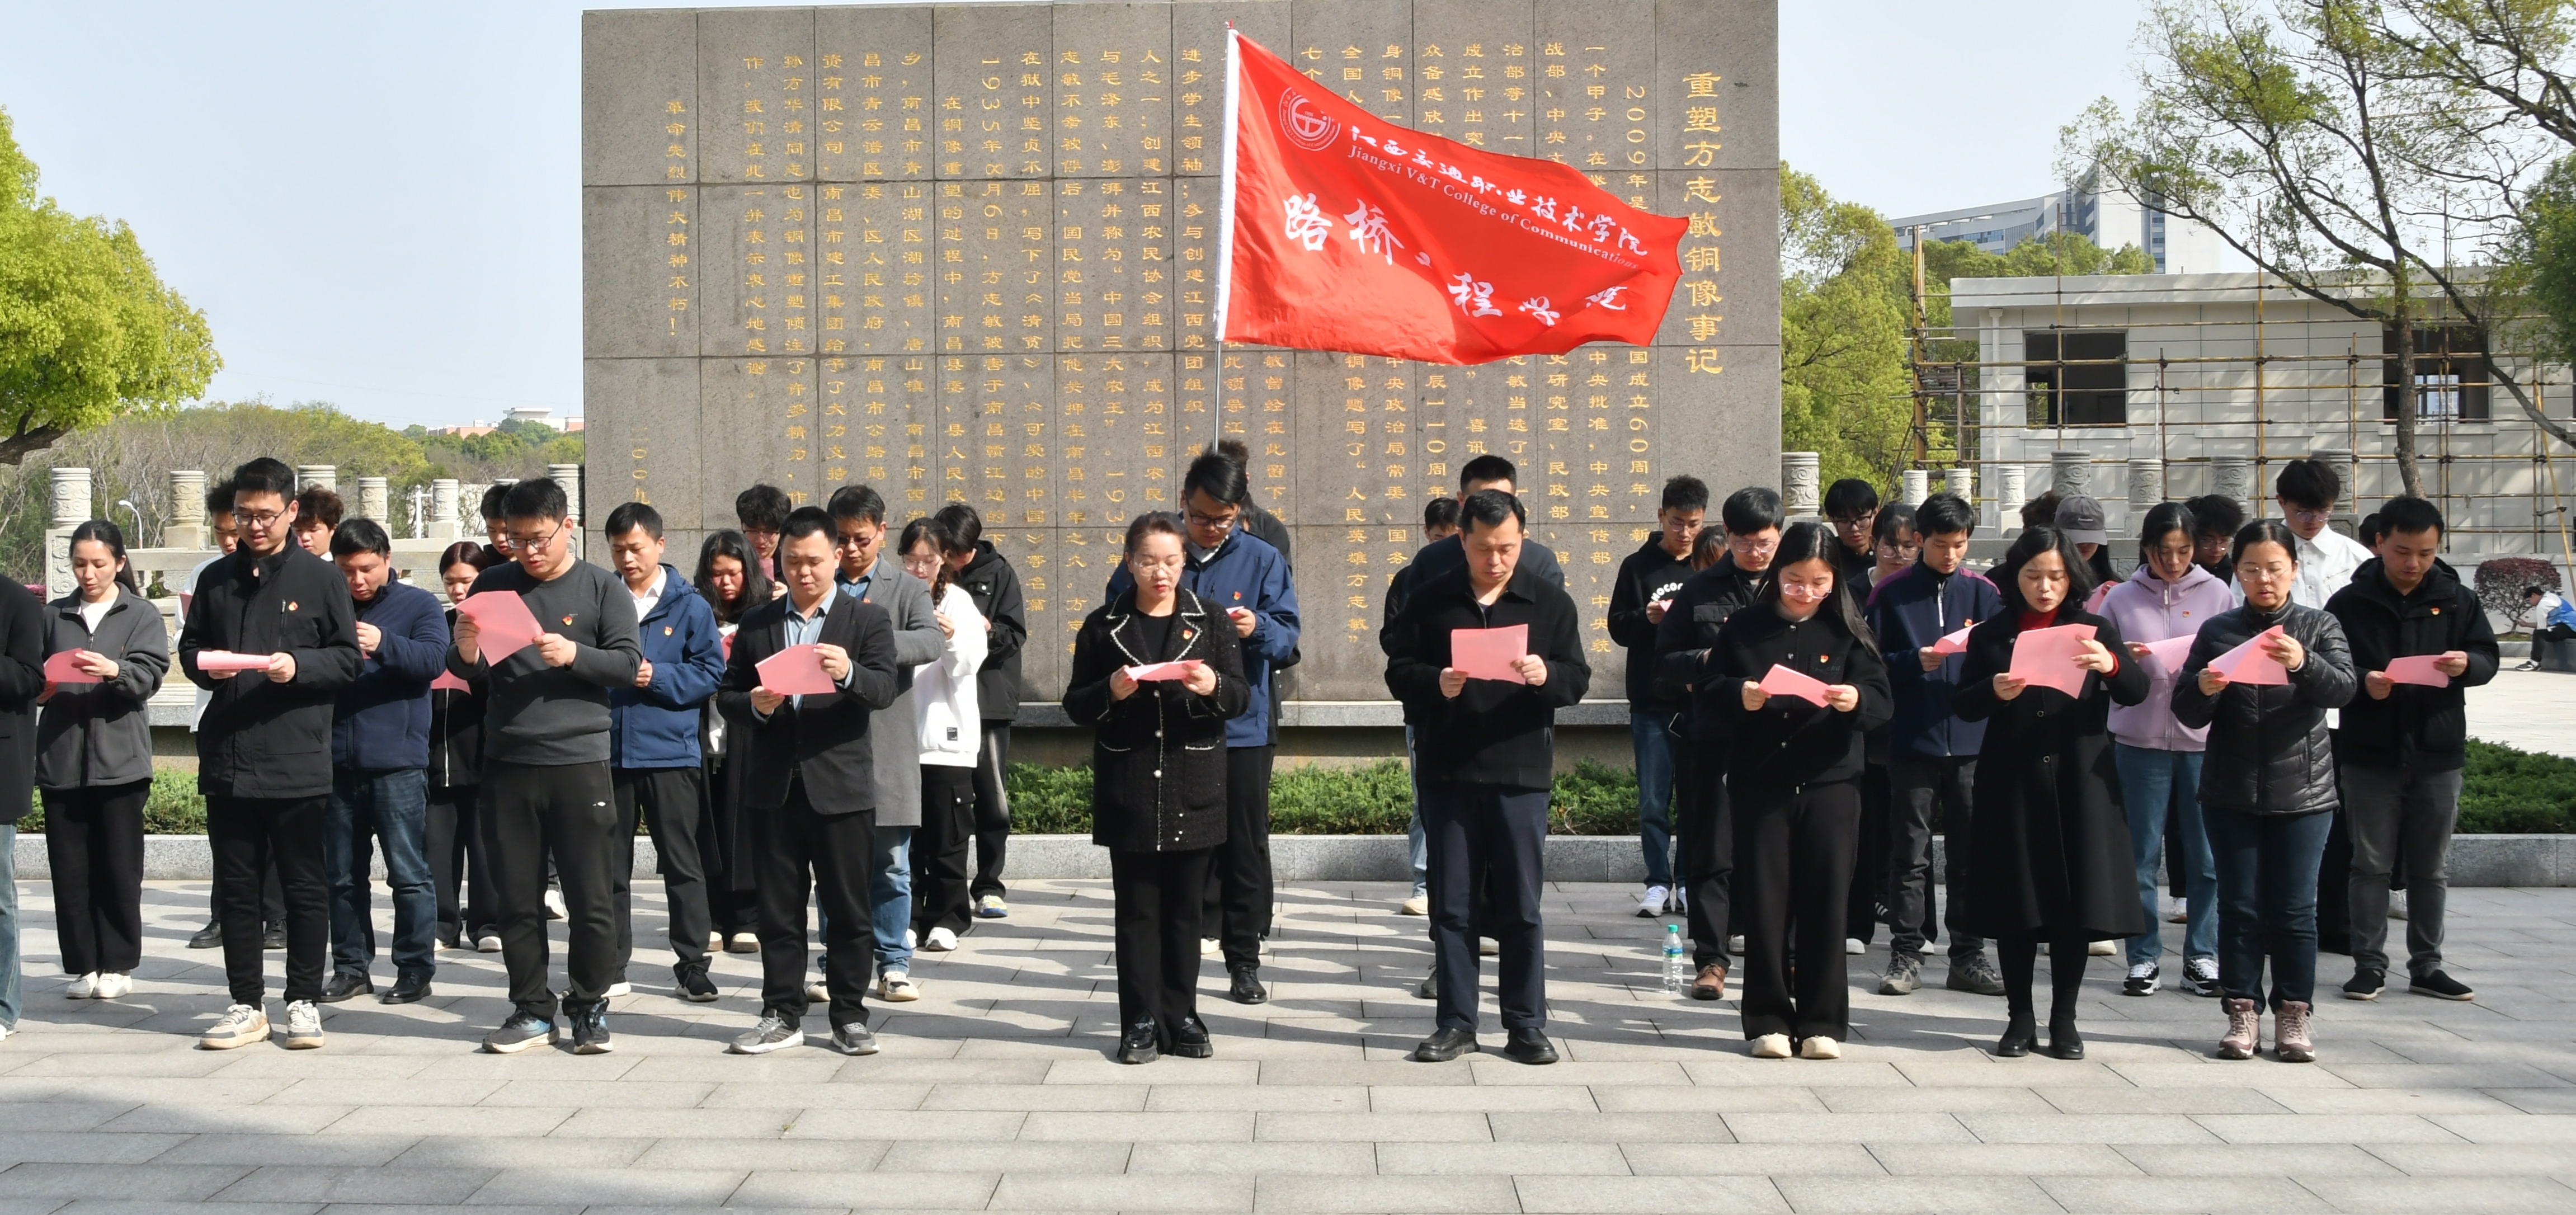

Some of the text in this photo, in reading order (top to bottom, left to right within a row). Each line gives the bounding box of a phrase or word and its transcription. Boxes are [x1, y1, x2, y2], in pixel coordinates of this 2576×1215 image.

[1301, 46, 1322, 81] 七个
[1343, 45, 1364, 103] 全国人
[1382, 44, 1404, 119] 身铜像一
[1423, 44, 1444, 138] 众备感欣
[1463, 43, 1485, 146] 成立作出突
[1504, 44, 1525, 157] 治部等十一
[1348, 145, 1638, 270] Jiangxi V&T College of Communications
[1349, 125, 1648, 256] 江西交通职业技术学院
[1626, 87, 1649, 209] 2009年是
[666, 101, 689, 335] 革命先烈伟大精神不朽！
[1283, 192, 1628, 327] 路桥程学院
[1683, 71, 1722, 374] 重塑方志敏铜像事记
[1101, 50, 1125, 566] 与毛泽东、澎湃并称为“中国三大农王”。1935年
[1467, 364, 1489, 454] ”。喜讯
[1547, 354, 1571, 586] 史研究室、民政部、解
